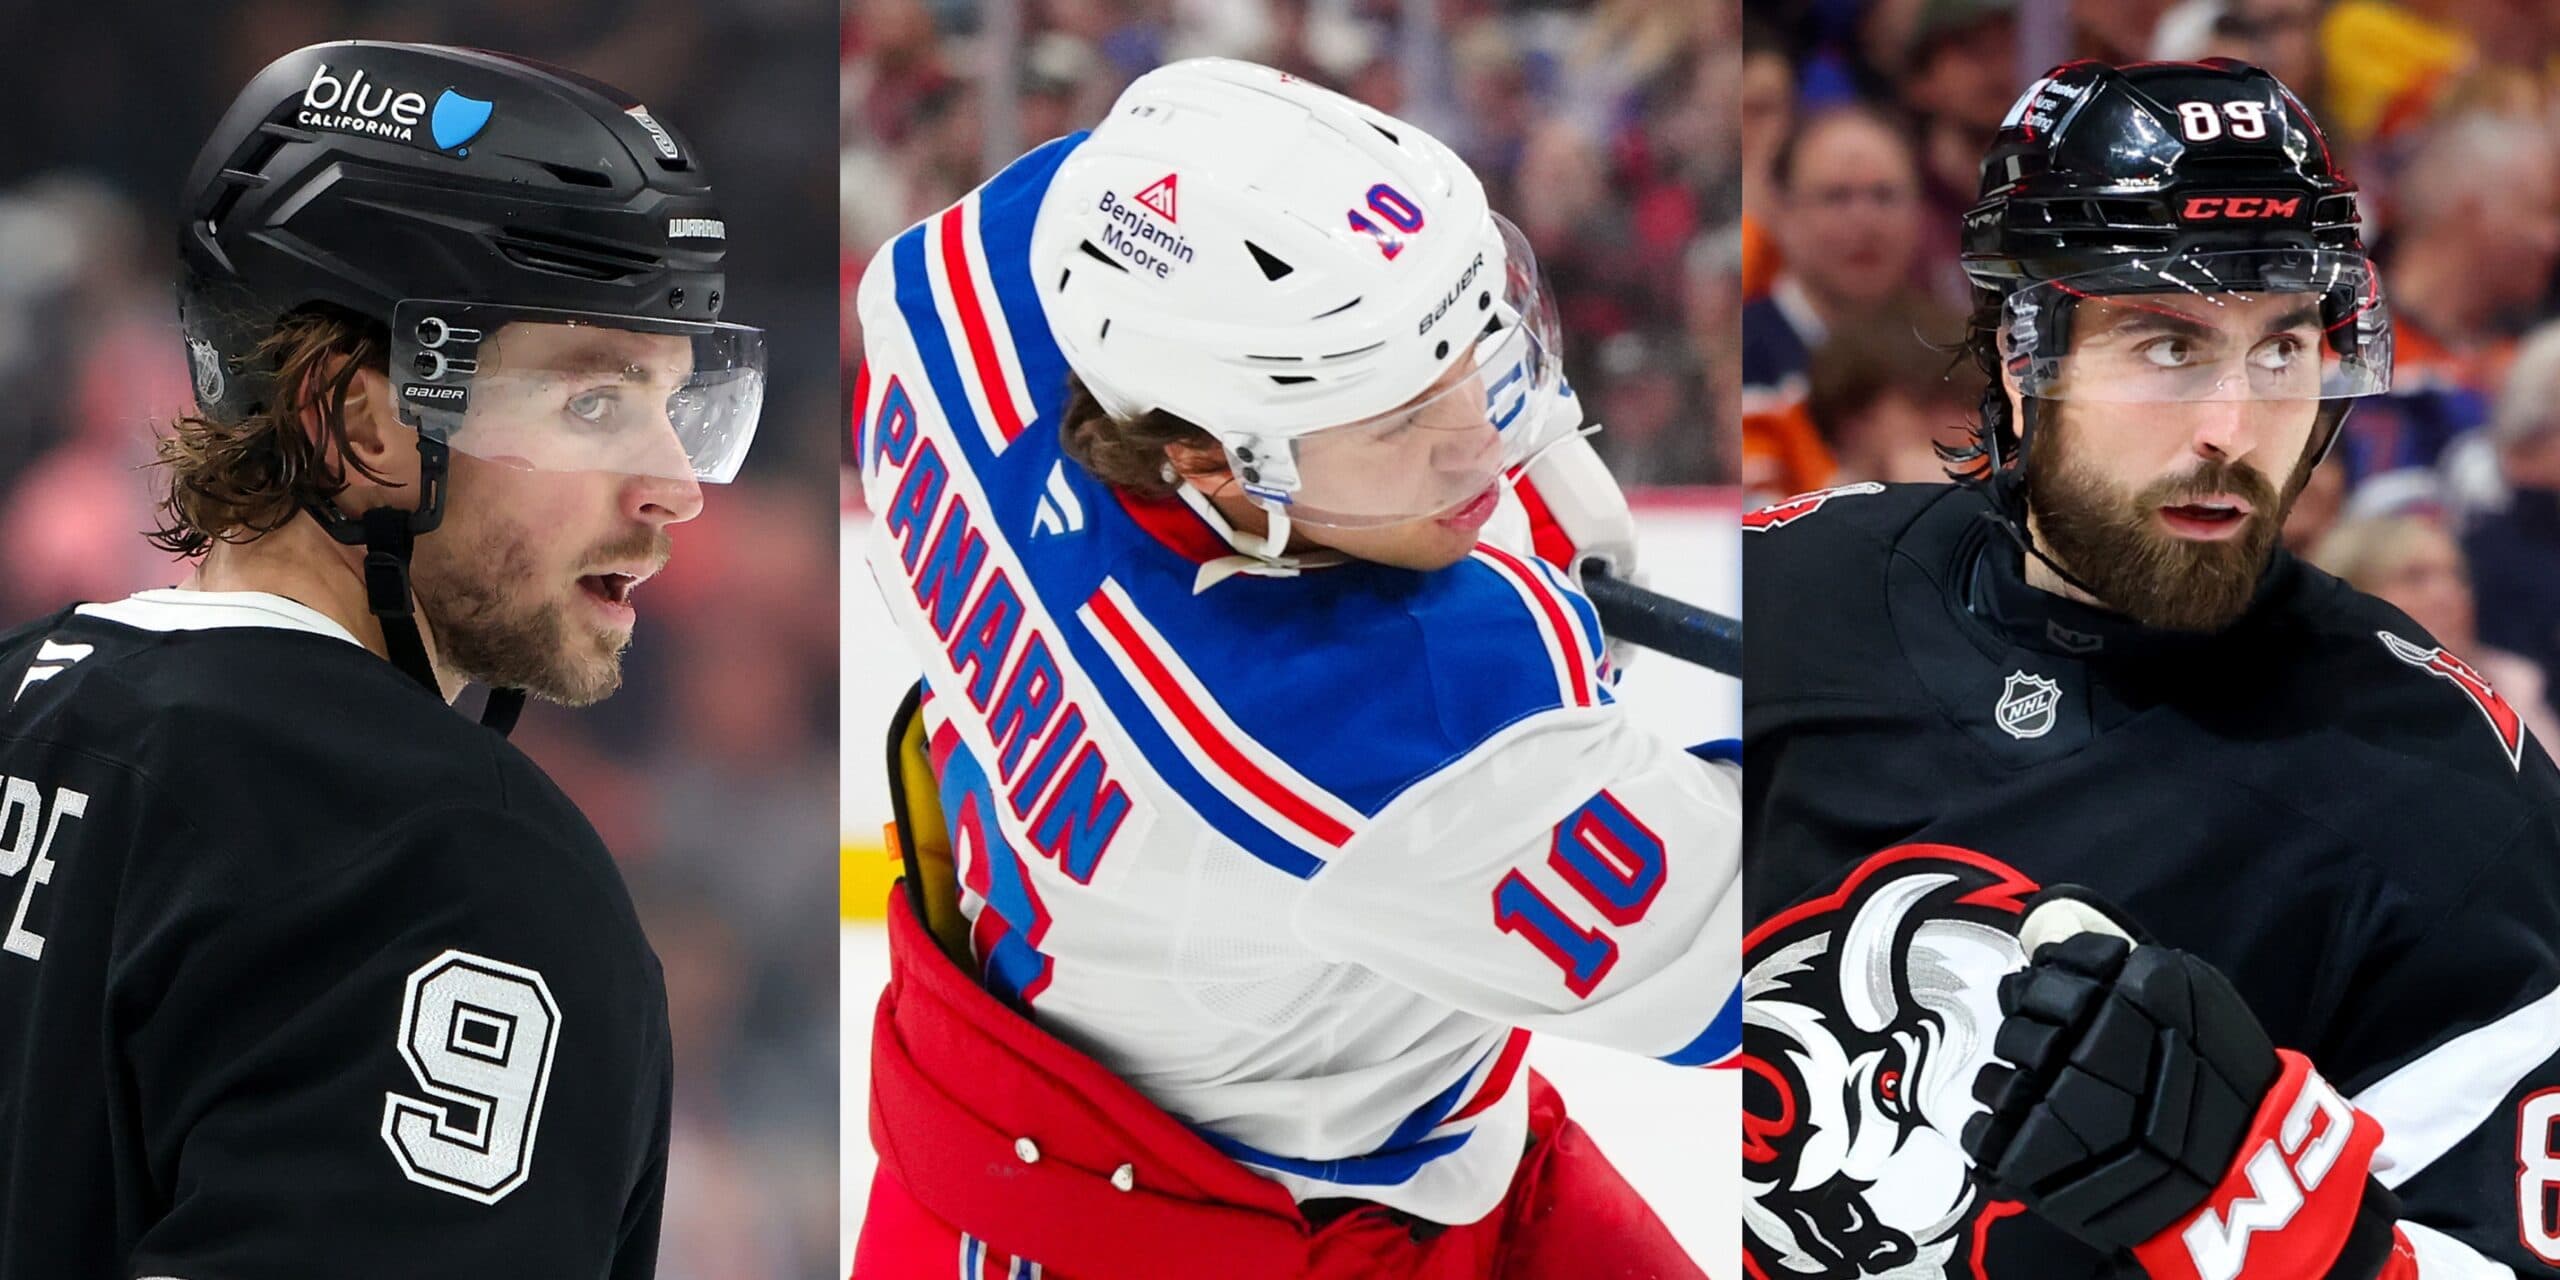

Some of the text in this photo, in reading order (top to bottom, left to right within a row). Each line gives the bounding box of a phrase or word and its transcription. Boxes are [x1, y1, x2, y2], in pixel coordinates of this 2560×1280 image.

[299, 111, 413, 141] CALIFORNIA
[303, 64, 426, 125] blue
[2176, 99, 2268, 142] 89
[1099, 190, 1194, 264] Benjamin
[1347, 183, 1424, 261] 10
[2183, 197, 2300, 219] CCM
[1102, 223, 1169, 279] Moore
[874, 374, 1132, 885] PANARIN
[2007, 694, 2048, 721] NHL
[0, 775, 89, 961] PE
[1491, 788, 1668, 1000] 10
[381, 949, 562, 1205] 9
[2182, 1067, 2354, 1280] CM
